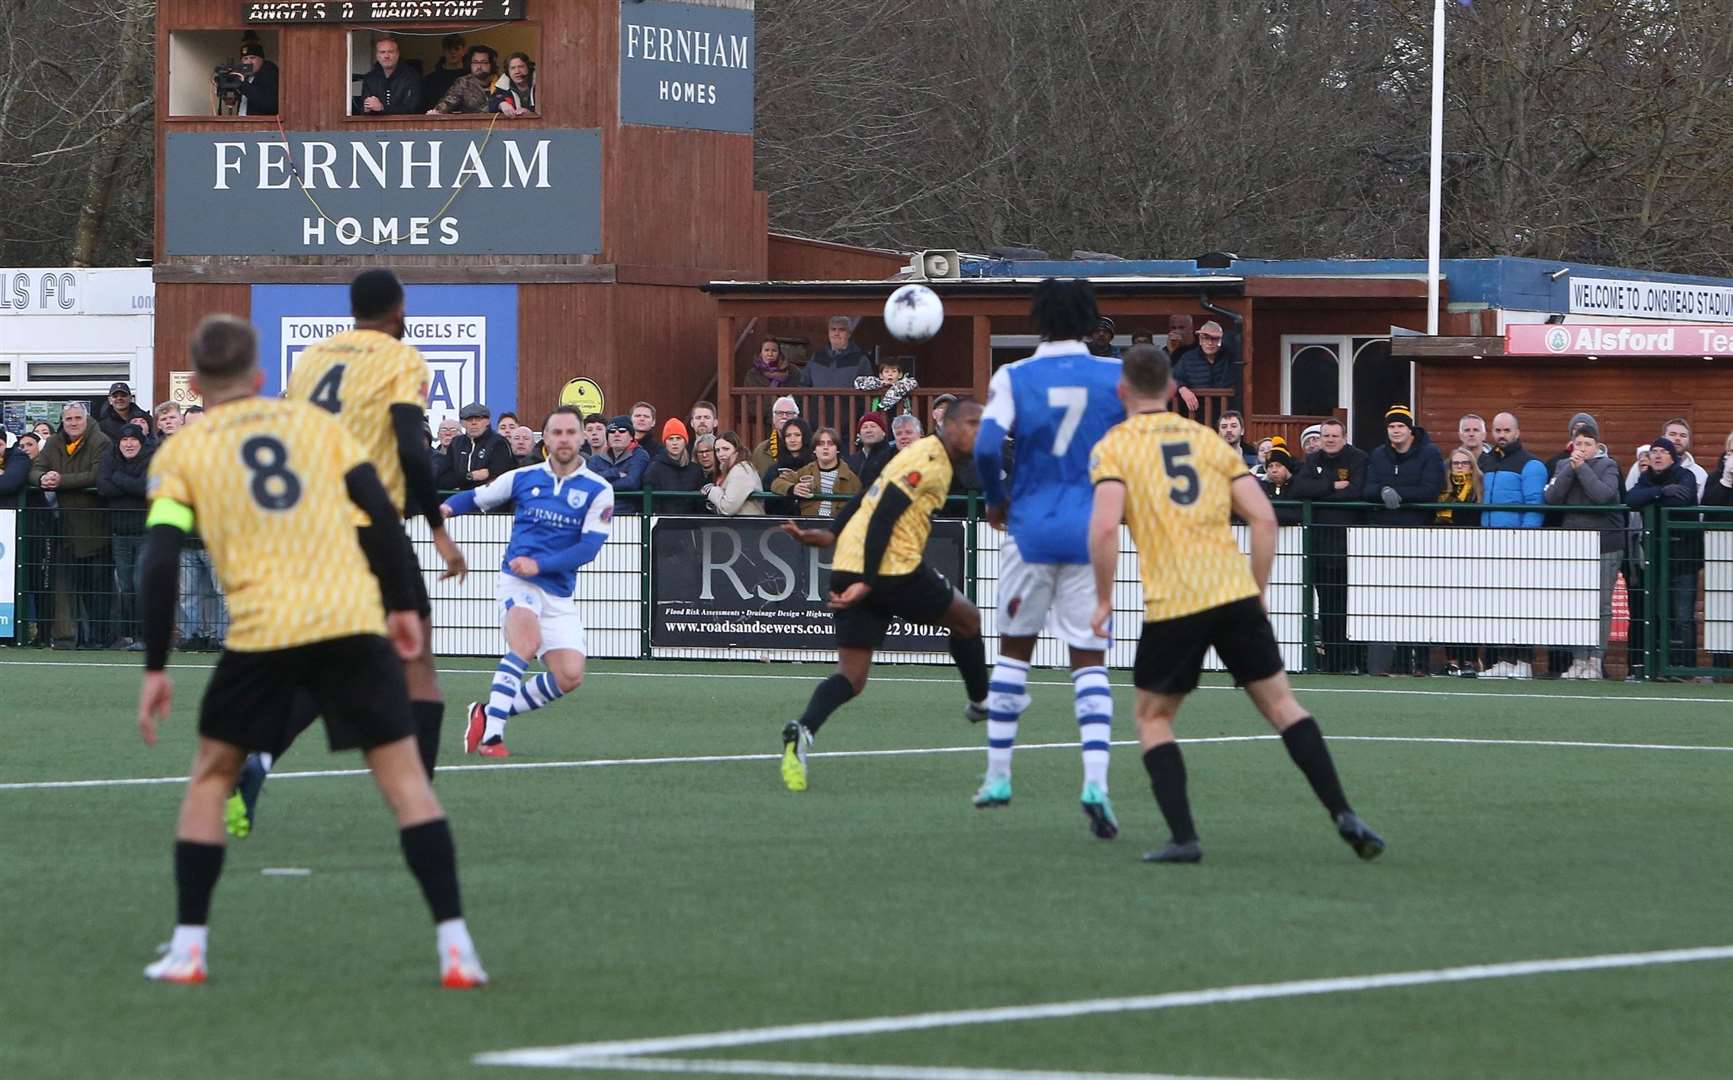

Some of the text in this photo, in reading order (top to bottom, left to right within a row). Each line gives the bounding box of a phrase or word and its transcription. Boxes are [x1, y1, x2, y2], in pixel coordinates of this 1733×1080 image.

[501, 0, 510, 16] 1
[627, 24, 748, 69] FERNHAM
[659, 80, 716, 104] HOMES
[213, 140, 551, 189] FERNHAM
[303, 217, 459, 245] HOMES
[40, 272, 76, 310] FC
[132, 295, 155, 309] LON
[1574, 284, 1624, 309] WELCOME
[1627, 287, 1640, 310] TO
[1697, 292, 1733, 316] STADIU
[403, 324, 452, 338] NGELS
[457, 323, 476, 338] FC
[1574, 328, 1733, 352] Alsford Te
[309, 363, 346, 414] 4
[1047, 387, 1087, 457] 7
[242, 436, 301, 511] 8
[1161, 442, 1200, 506] 5
[701, 608, 740, 616] Assessments
[746, 609, 776, 617] Drainage
[777, 610, 799, 618] Design
